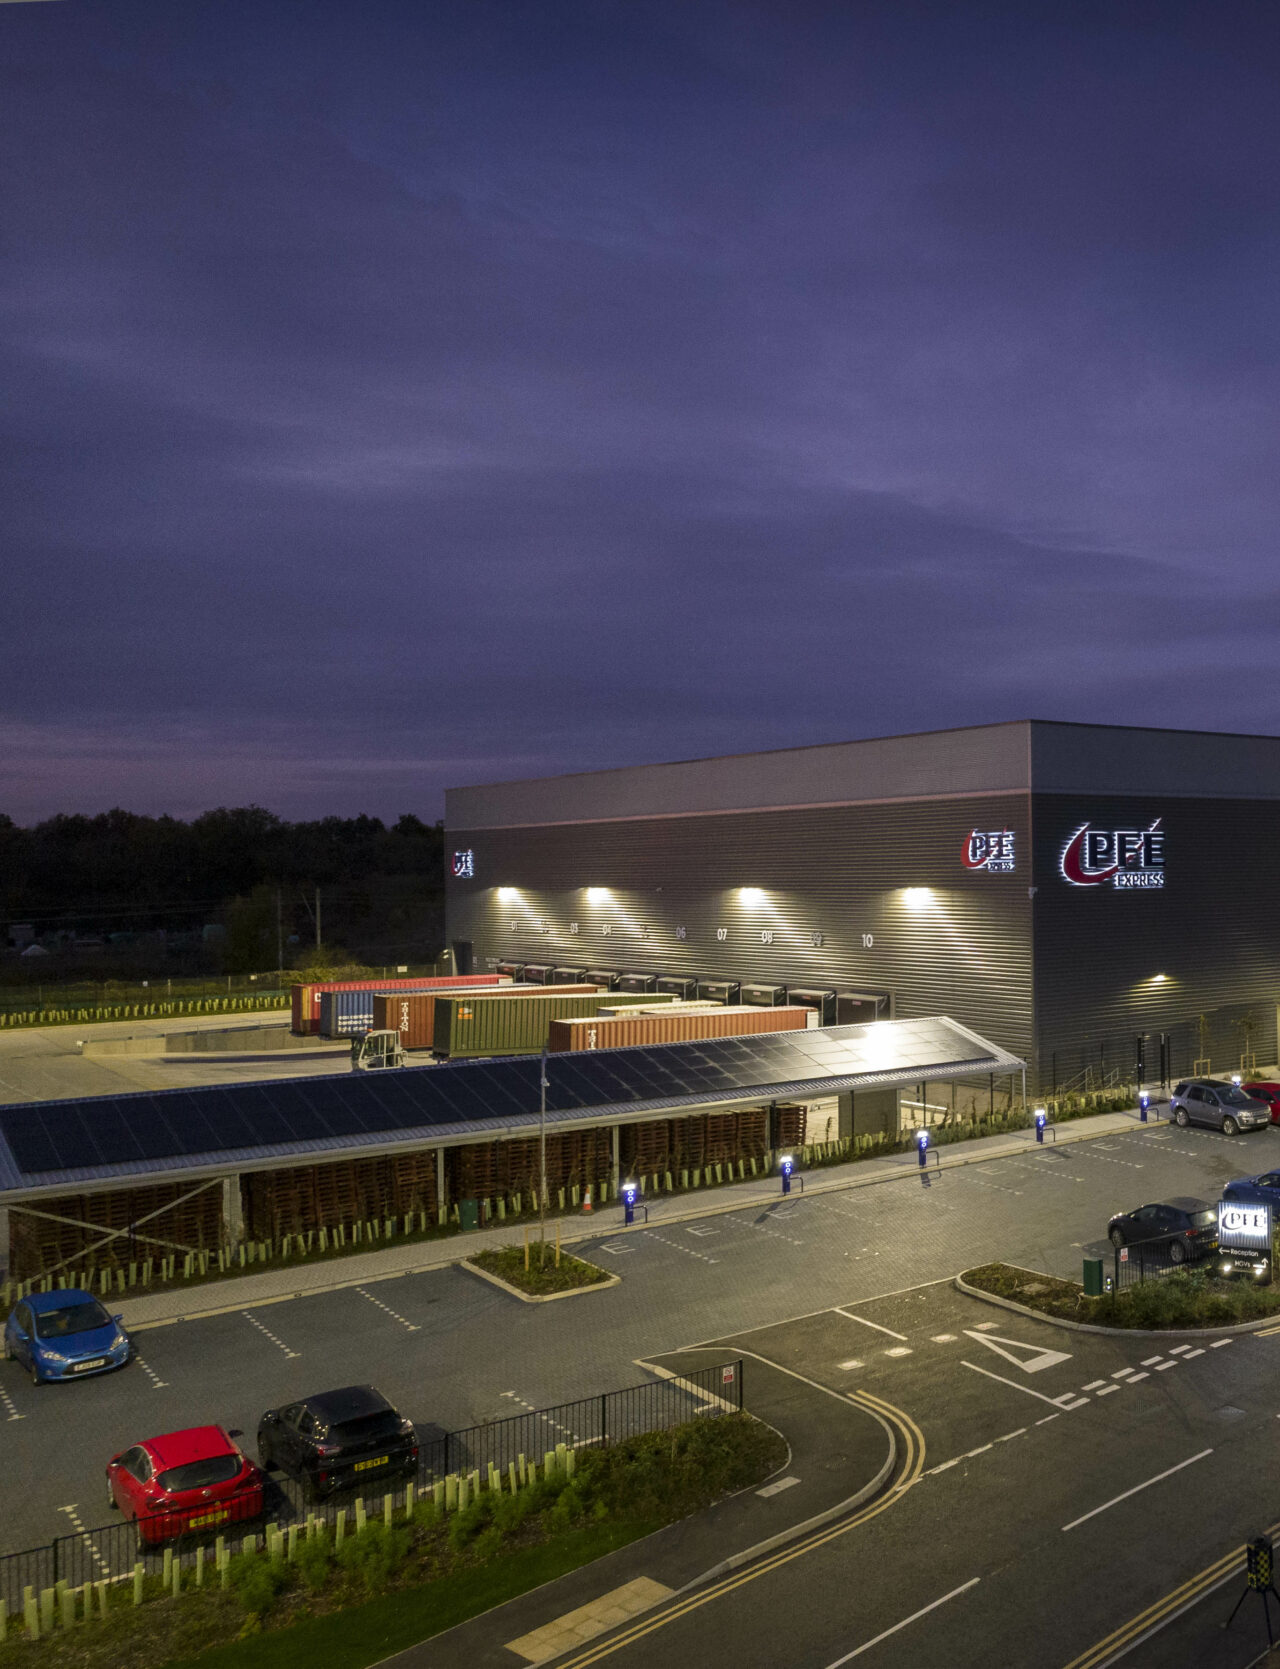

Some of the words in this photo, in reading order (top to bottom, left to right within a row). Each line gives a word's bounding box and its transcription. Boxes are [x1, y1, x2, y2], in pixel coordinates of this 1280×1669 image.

[1113, 873, 1164, 888] EXPRESS
[676, 927, 686, 938] 06
[717, 928, 727, 941] 07
[761, 930, 773, 944] 08
[862, 934, 873, 948] 10
[400, 1002, 409, 1032] TRITON
[1230, 1249, 1259, 1257] Reception
[1234, 1260, 1251, 1268] HGVs
